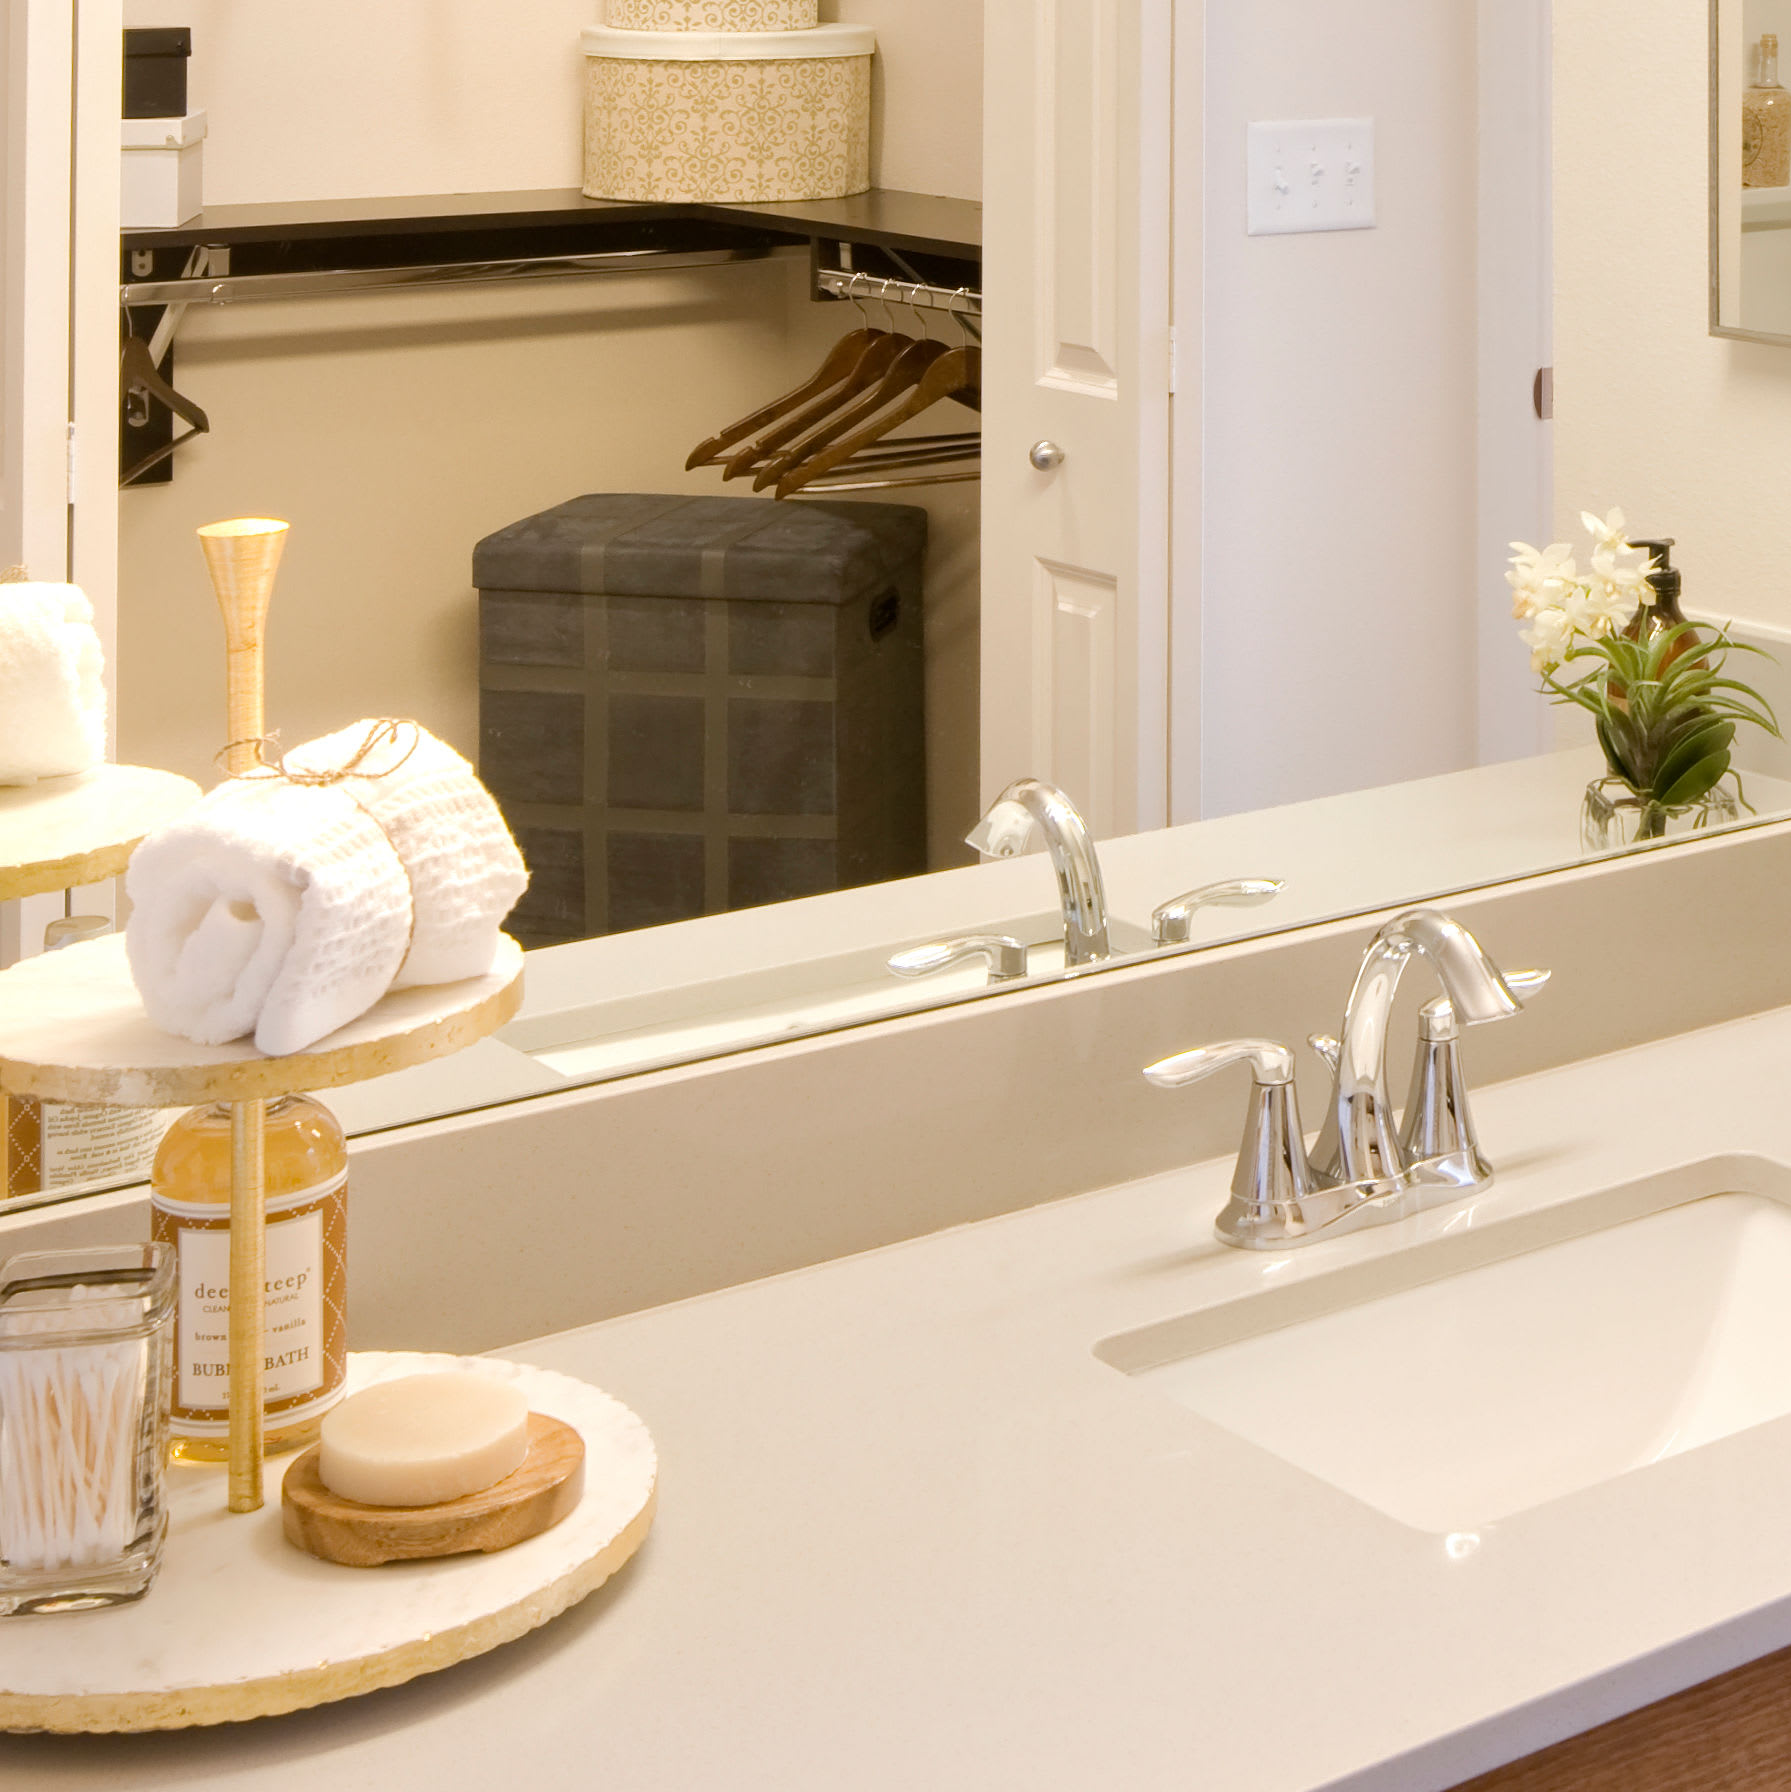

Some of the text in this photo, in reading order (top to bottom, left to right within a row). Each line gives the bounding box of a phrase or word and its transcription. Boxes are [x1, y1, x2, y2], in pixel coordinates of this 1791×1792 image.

[194, 1272, 307, 1299] dee teep
[194, 1318, 306, 1341] brown vanilla
[264, 1346, 309, 1371] BATH
